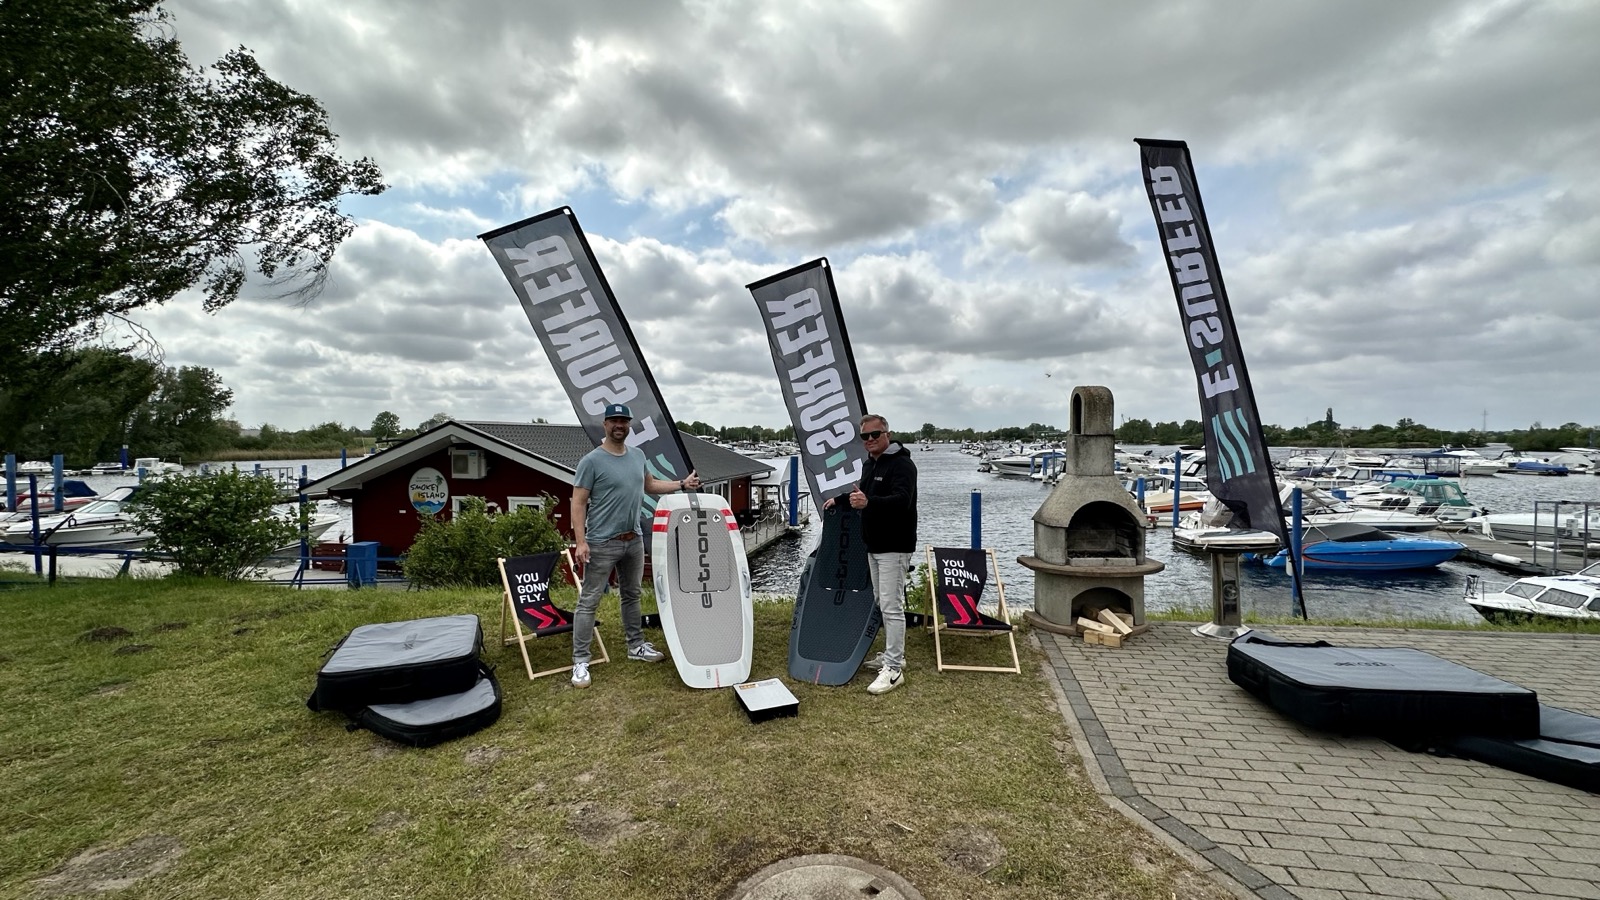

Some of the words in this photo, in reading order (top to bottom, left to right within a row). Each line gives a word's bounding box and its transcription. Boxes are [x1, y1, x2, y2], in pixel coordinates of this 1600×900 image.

[410, 484, 439, 493] SMOKEY
[697, 521, 713, 609] e-tron
[942, 559, 965, 568] YOU
[515, 572, 539, 584] YOU
[943, 568, 980, 584] GONNA
[517, 580, 550, 594] GONN
[945, 577, 968, 589] FLY.
[519, 593, 545, 604] FLY.
